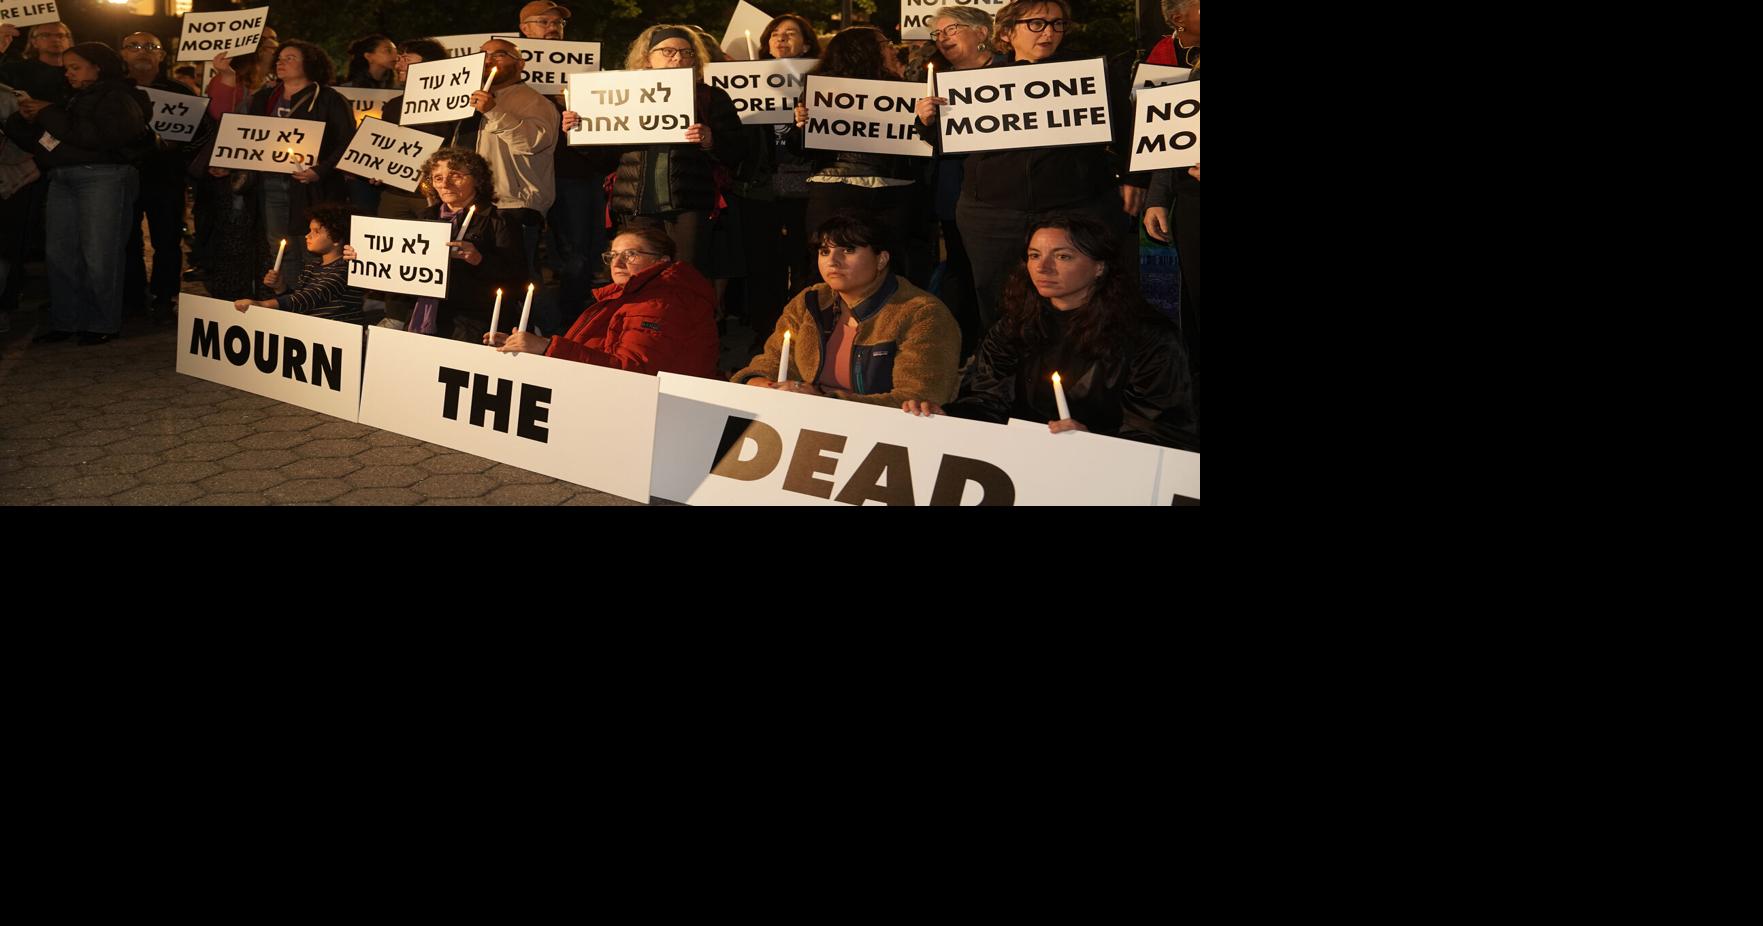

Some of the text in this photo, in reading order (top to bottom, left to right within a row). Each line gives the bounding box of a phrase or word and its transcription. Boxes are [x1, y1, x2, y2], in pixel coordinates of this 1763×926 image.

[0, 2, 55, 20] RE LIFE
[188, 17, 262, 33] NOT ONE
[181, 33, 260, 51] MORE LIFE
[521, 50, 594, 65] OT ONE
[419, 66, 471, 90] לא עוד
[520, 70, 555, 84] ORE
[711, 73, 804, 89] NOT ON
[446, 94, 470, 110] פש
[591, 82, 671, 106] לא עוד
[813, 91, 916, 113] NOT ON
[948, 76, 1096, 106] NOT ONE
[161, 102, 189, 116] לא
[404, 98, 441, 114] אחת
[732, 96, 799, 112] ORE LI
[1146, 98, 1200, 123] NO
[154, 120, 195, 135] נפש
[574, 114, 690, 132] נפש אחת
[808, 117, 921, 140] MORE LIF
[945, 106, 1106, 136] MORE LIFE
[237, 127, 305, 144] לא עוד
[370, 132, 423, 158] לא עוד
[1136, 130, 1197, 154] MO
[215, 146, 264, 161] אחת
[344, 149, 422, 182] נפש אחת
[364, 233, 429, 255] לא עוד
[350, 259, 444, 285] נפש אחת
[189, 317, 343, 392] MOURN
[437, 365, 553, 444] THE
[709, 415, 1016, 506] DEAD
